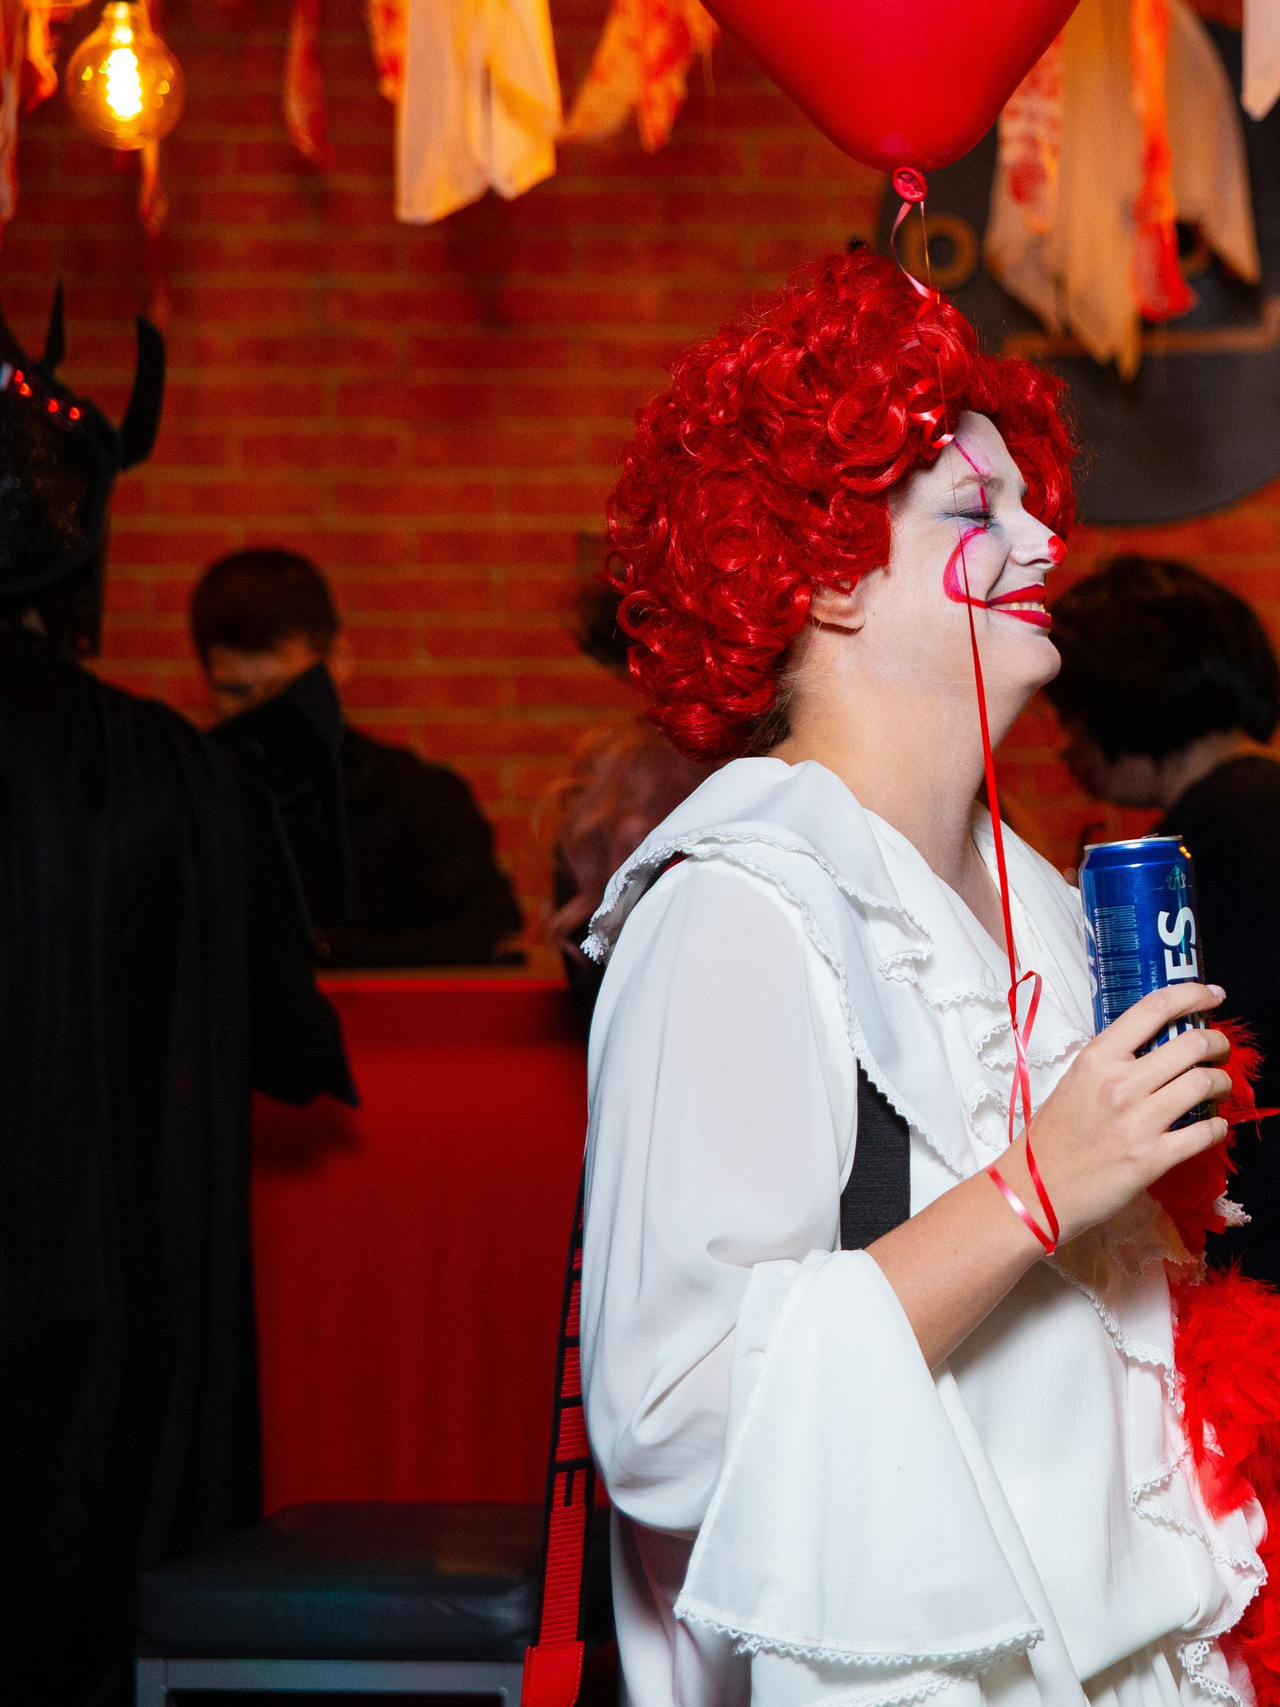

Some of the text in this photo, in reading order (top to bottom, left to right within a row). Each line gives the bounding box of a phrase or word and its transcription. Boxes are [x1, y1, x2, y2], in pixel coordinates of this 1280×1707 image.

[1094, 905, 1140, 953] ЗДОРОВЬЮ
[1099, 955, 1143, 989] ВРЕДИТ
[1149, 959, 1158, 982] MALT
